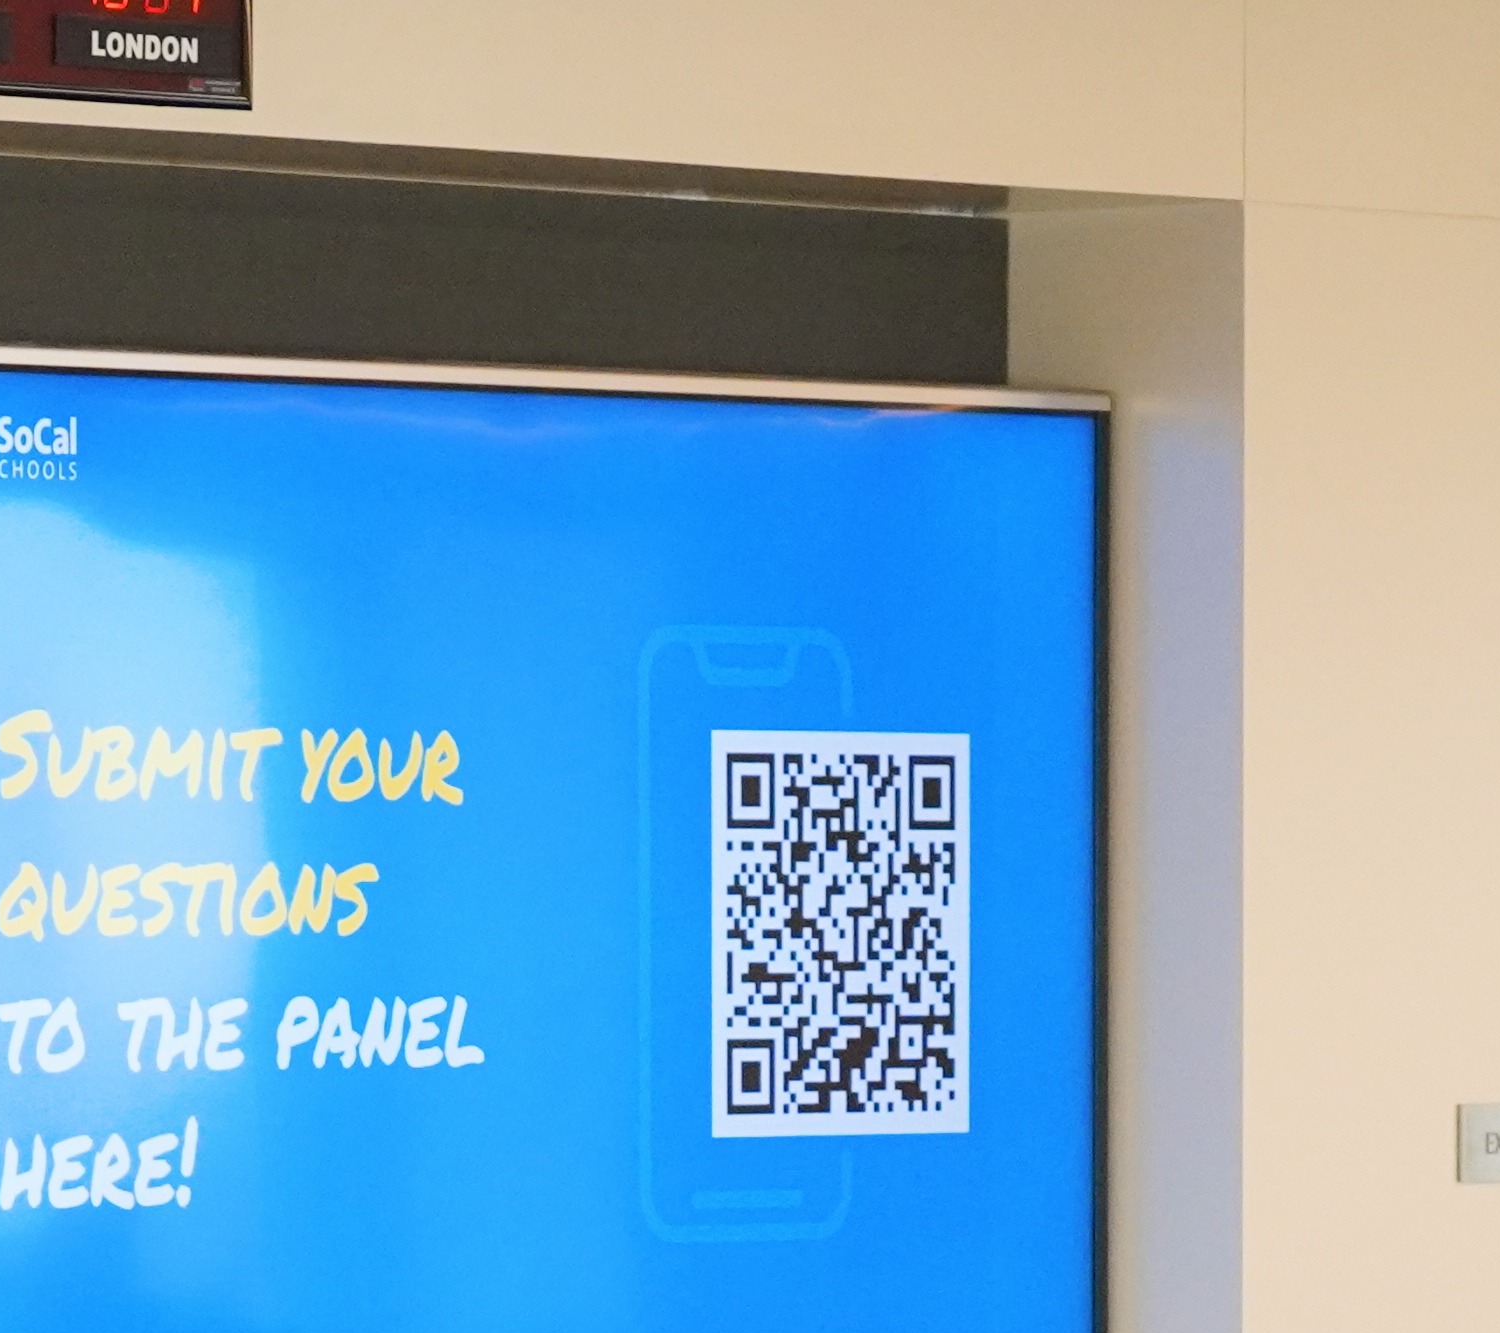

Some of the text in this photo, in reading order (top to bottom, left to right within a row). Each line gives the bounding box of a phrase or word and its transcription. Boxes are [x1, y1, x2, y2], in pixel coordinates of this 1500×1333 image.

[91, 29, 199, 63] LONDON
[300, 727, 465, 806] YOUR
[117, 996, 247, 1073] THE
[275, 995, 486, 1070] PANEL
